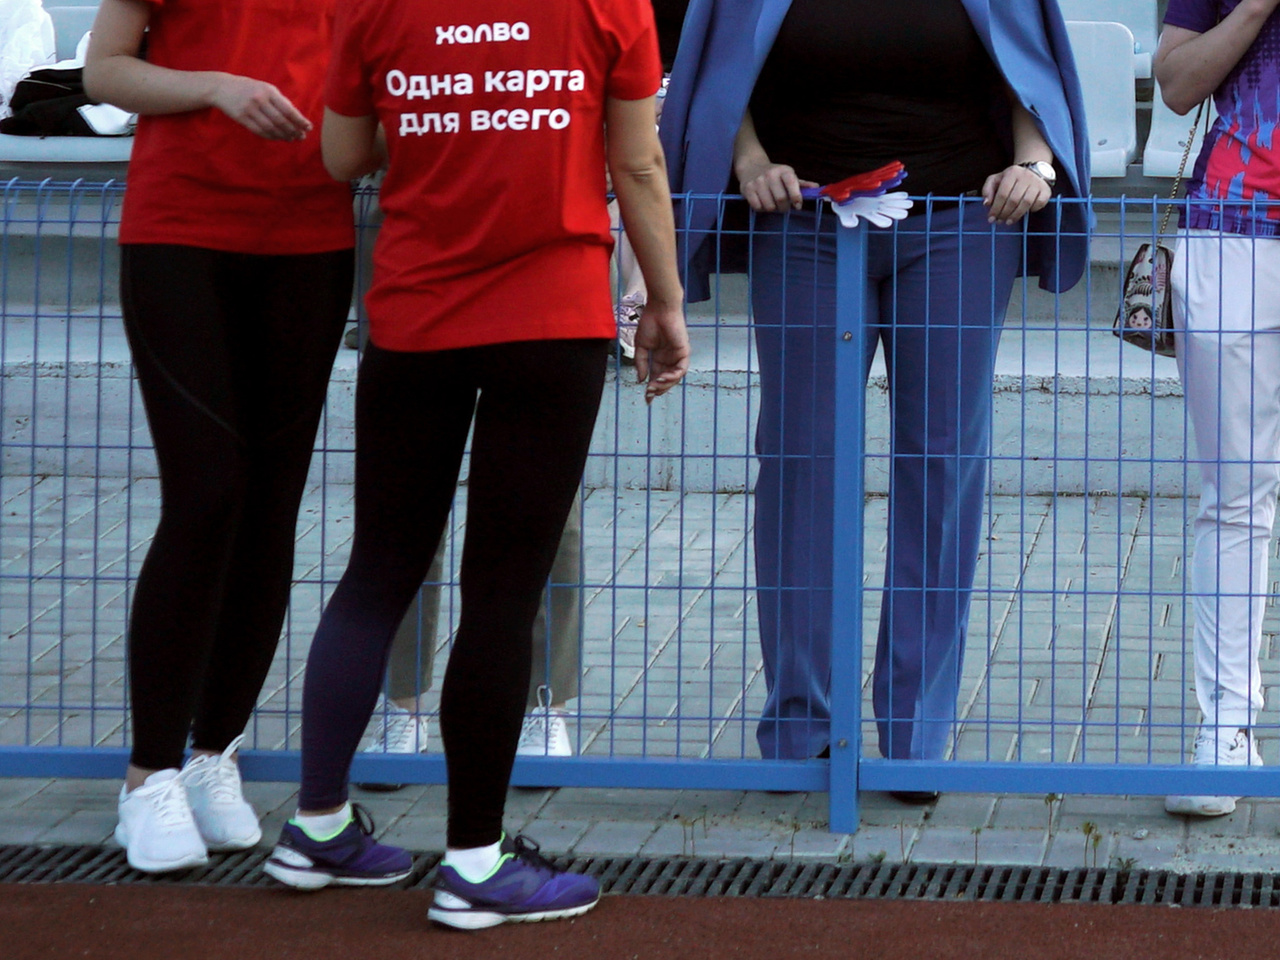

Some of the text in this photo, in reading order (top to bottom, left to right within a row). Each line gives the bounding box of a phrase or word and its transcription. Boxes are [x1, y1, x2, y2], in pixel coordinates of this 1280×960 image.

[385, 69, 585, 100] Одна карта
[399, 108, 570, 137] для всего
